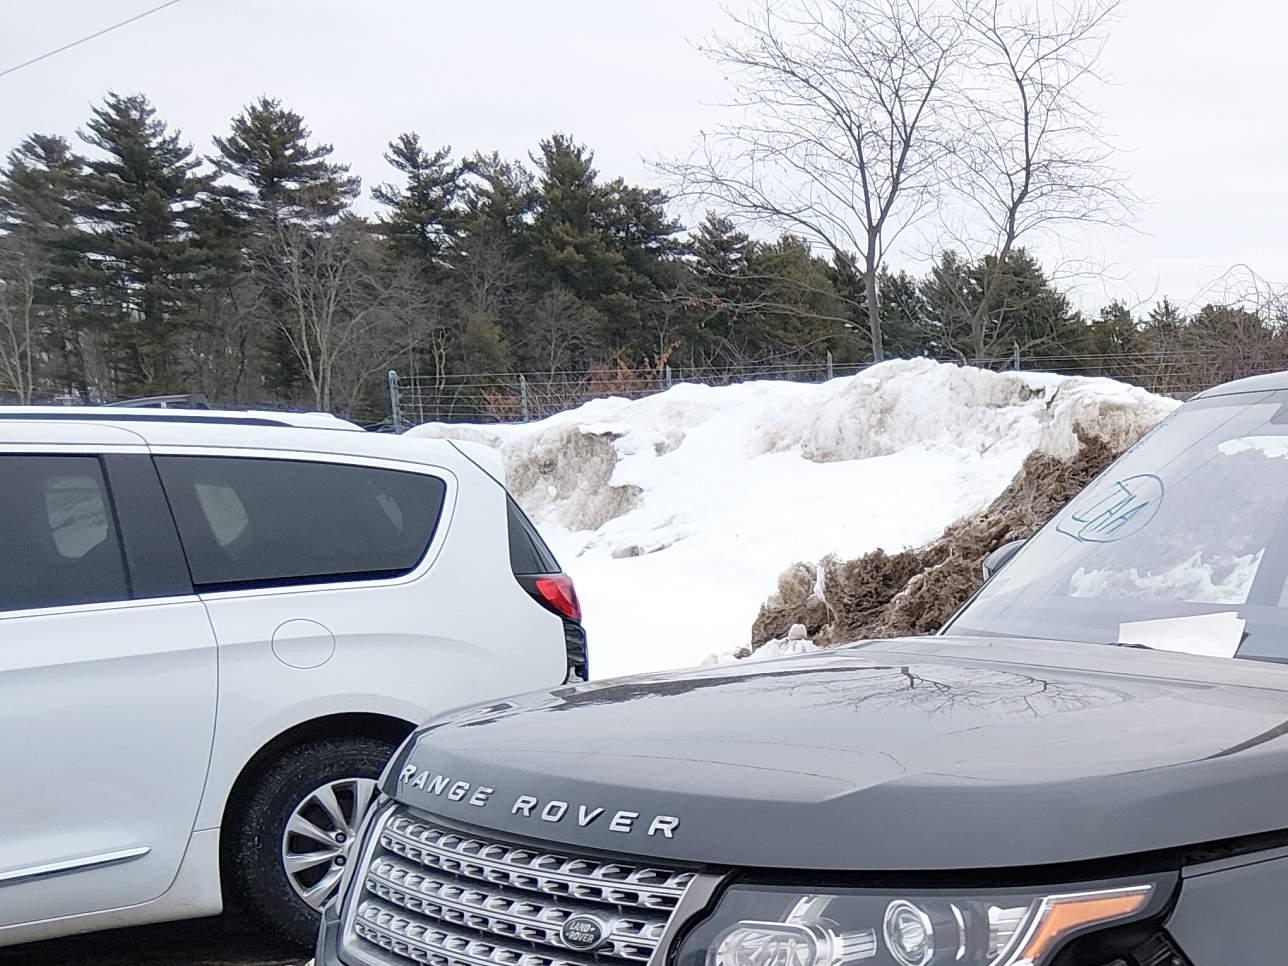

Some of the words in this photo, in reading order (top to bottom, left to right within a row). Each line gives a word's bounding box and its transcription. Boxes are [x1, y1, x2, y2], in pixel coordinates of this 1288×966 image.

[399, 763, 495, 807] RANGE
[511, 794, 680, 838] ROVER
[569, 921, 592, 933] LAND
[567, 930, 595, 944] ROVER
